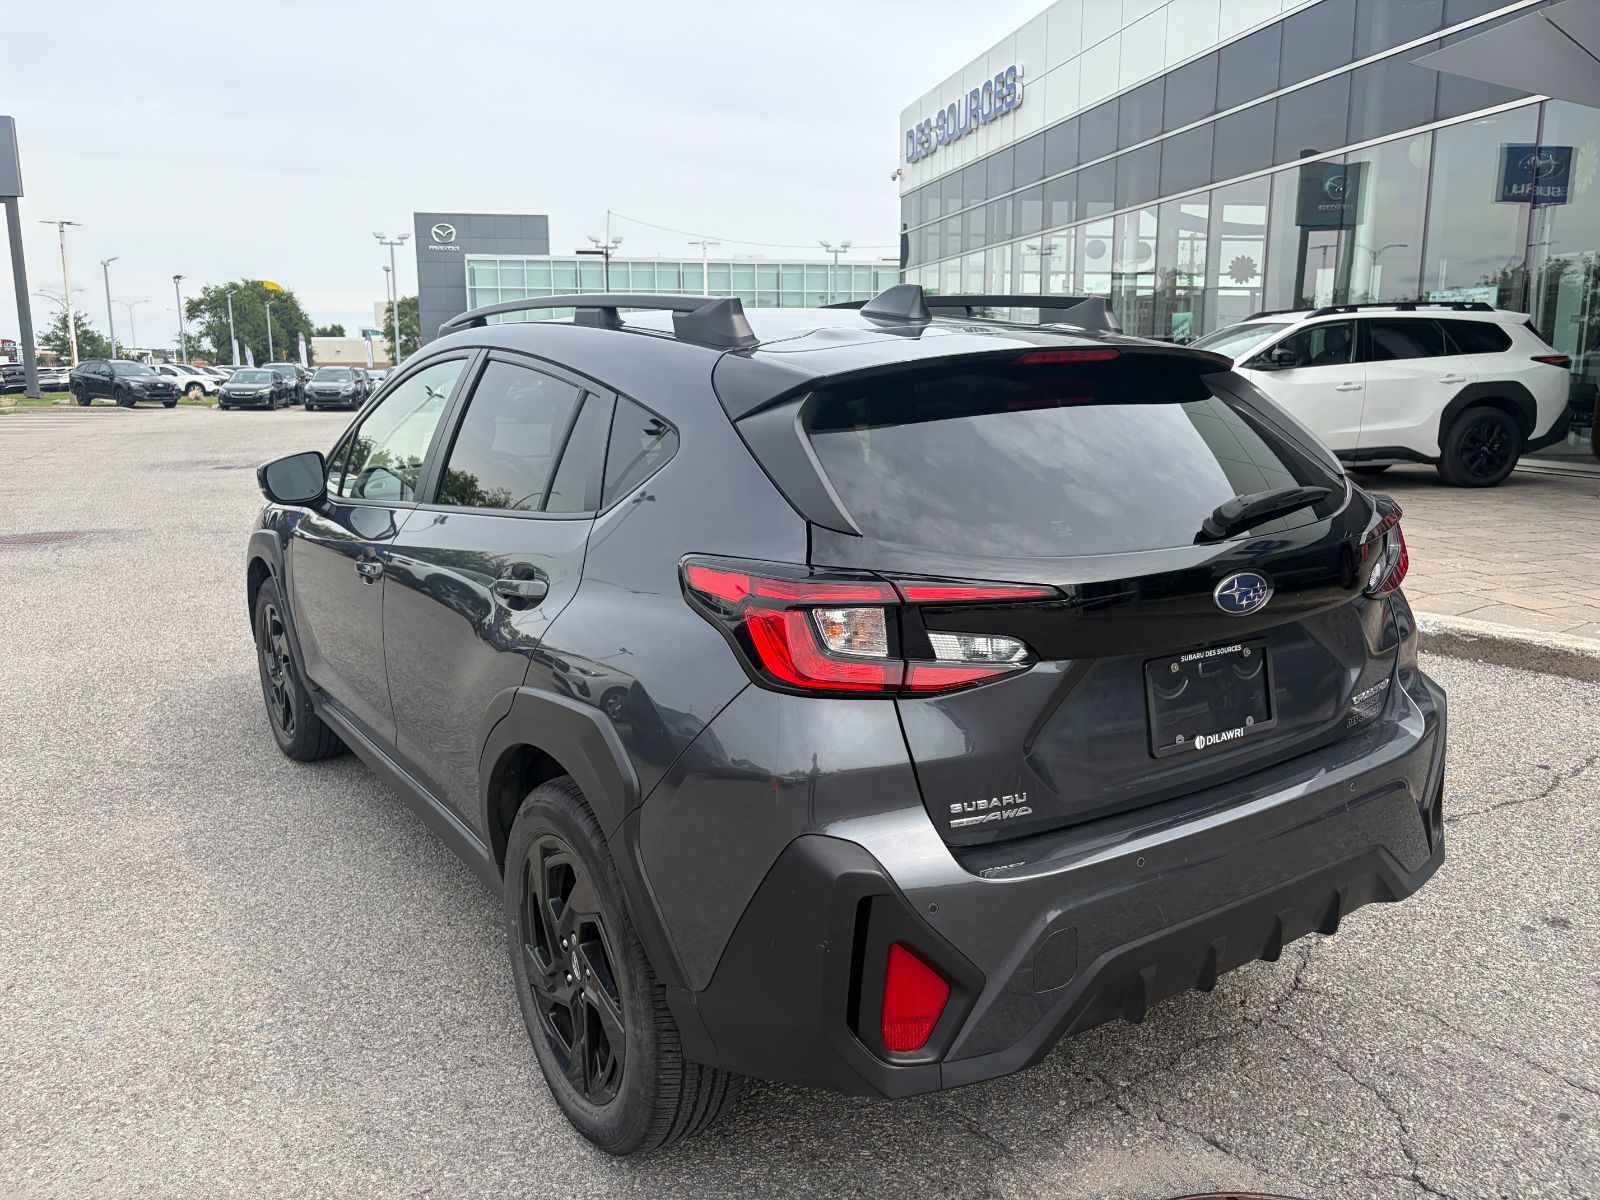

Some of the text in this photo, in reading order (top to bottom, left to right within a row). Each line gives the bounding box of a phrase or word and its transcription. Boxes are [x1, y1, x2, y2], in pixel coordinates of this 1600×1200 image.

[906, 64, 1022, 164] DES SOURCES
[1180, 644, 1242, 662] SUBARU DES SOURCES
[1206, 727, 1244, 746] DILAWRI
[949, 792, 1027, 814] SUBARU
[982, 806, 1033, 823] AWD
